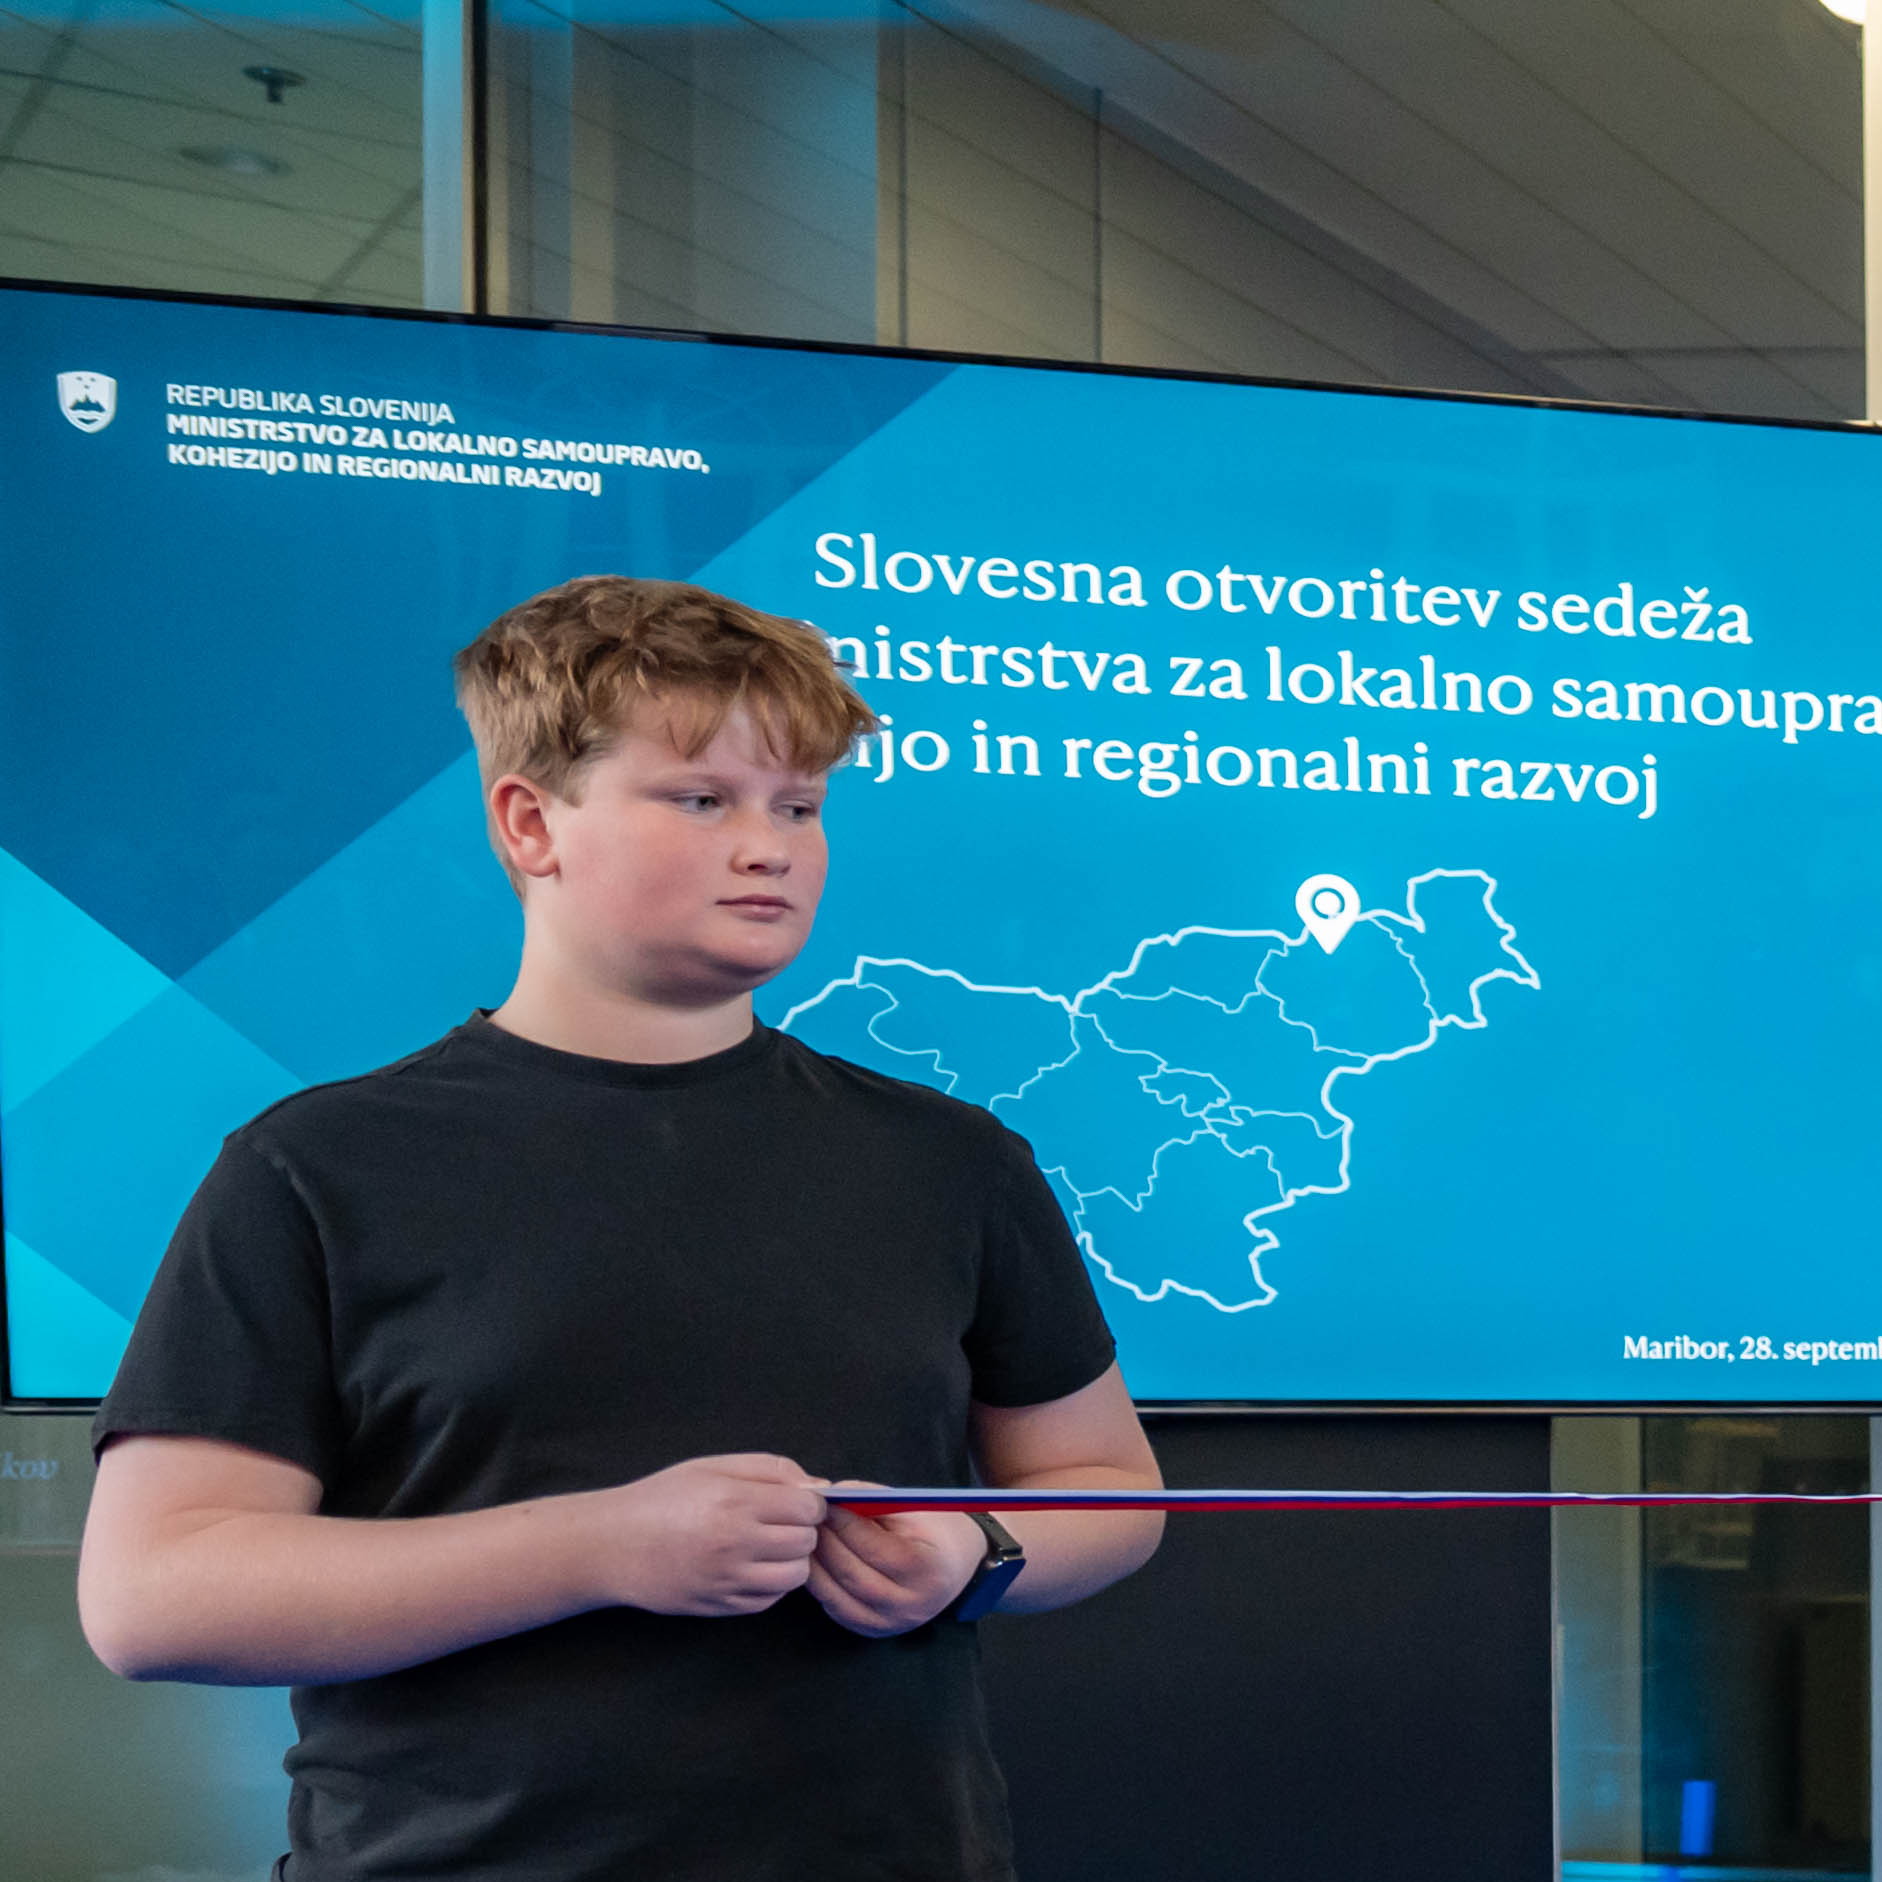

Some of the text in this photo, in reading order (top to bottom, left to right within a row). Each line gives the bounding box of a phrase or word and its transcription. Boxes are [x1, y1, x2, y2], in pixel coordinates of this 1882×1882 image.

[166, 383, 456, 427] REPUBLIKA SLOVENIJA
[166, 413, 710, 474] MINISTRSTVO ZA LOKALNO SAMOUPRAVO,
[167, 444, 602, 497] KOHEZIJO IN REGIONALNI RAZVOJ
[815, 532, 1753, 645] Slovesna otvoritev sedeža
[823, 624, 1153, 695] nistrstva
[1169, 656, 1249, 701] za
[1265, 645, 1533, 716] lokalno
[854, 714, 1658, 820] ijo in regionalni razvoj
[1623, 1335, 1735, 1363] Maribor,
[1739, 1335, 1779, 1361] 28.
